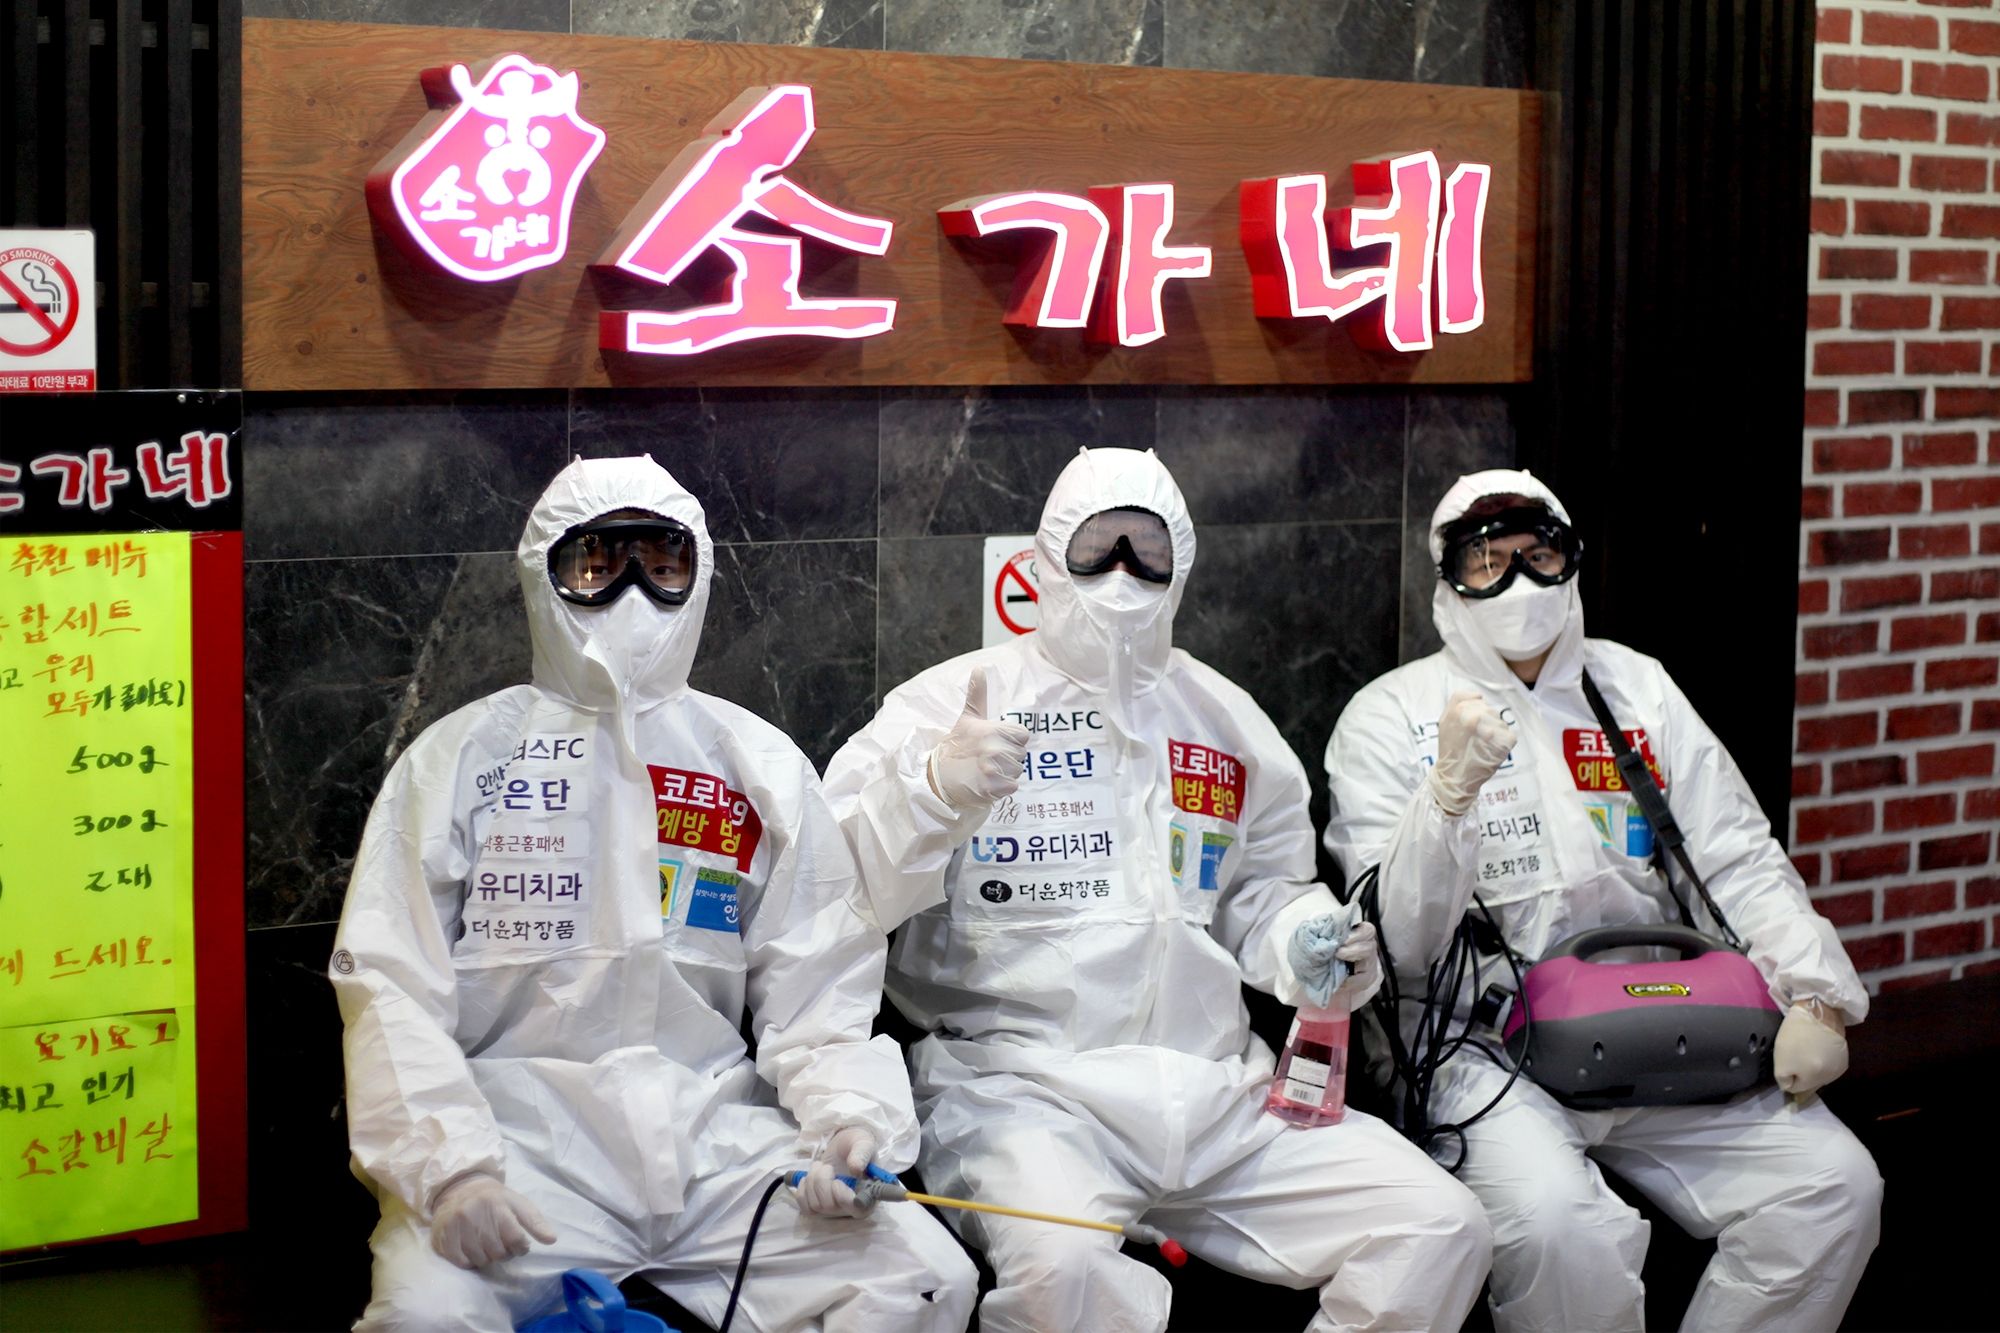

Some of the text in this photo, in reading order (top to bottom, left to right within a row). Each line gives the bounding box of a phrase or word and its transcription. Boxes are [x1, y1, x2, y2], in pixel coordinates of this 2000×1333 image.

[419, 165, 478, 222] 소
[616, 84, 1492, 354] 소가네
[10, 249, 56, 267] SMOKING
[32, 376, 65, 389] 10만원
[67, 375, 88, 389] 부과
[9, 540, 148, 578] 추천 메뉴
[32, 654, 94, 683] 우리
[657, 808, 709, 845] 예방
[1025, 830, 1113, 862] 유디치과
[477, 872, 583, 902] 유디치과
[1019, 880, 1110, 901] 더윤화장품
[472, 919, 576, 942] 더윤화장품
[81, 1066, 134, 1105] 인기
[16, 1112, 174, 1180] 소갈비살
